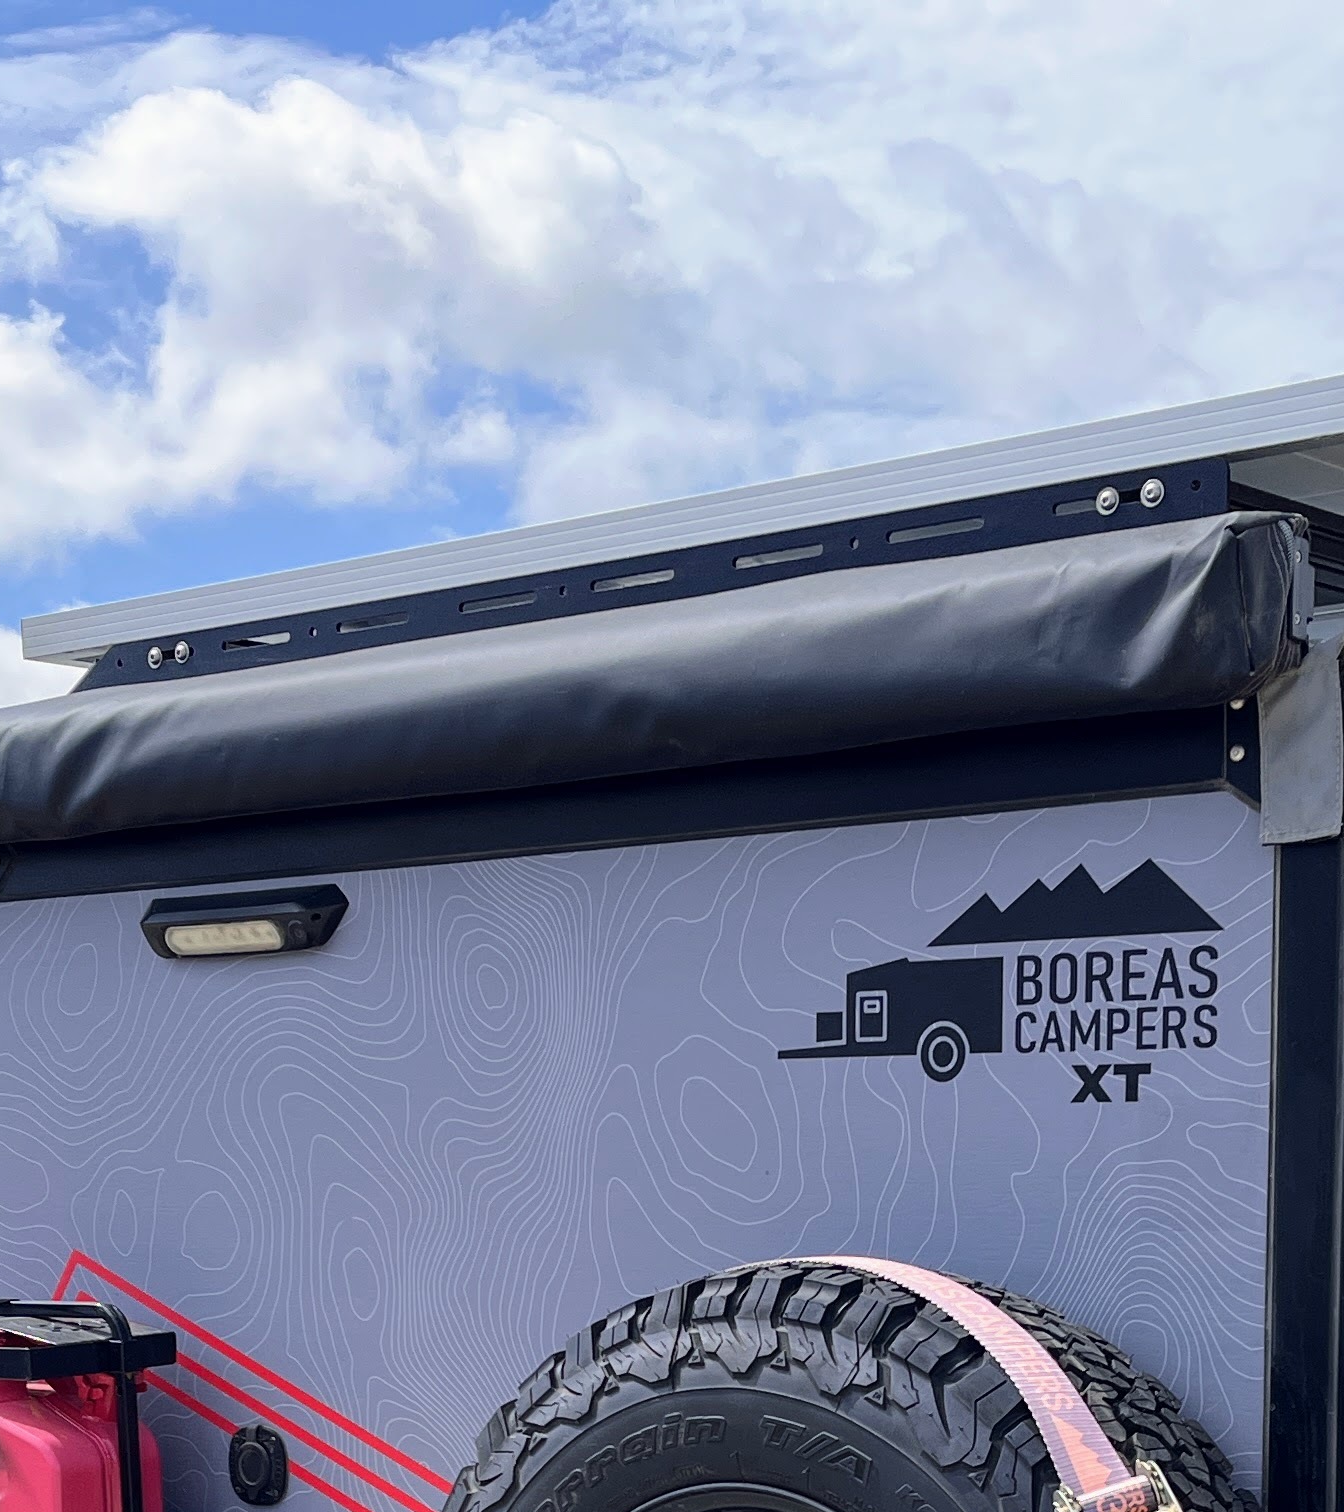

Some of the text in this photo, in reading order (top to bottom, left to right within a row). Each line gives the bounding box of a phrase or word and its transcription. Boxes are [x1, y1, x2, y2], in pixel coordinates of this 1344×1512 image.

[1015, 945, 1219, 1006] BOREAS
[1014, 1004, 1219, 1054] CAMPERS
[1070, 1062, 1152, 1104] XT
[758, 1414, 873, 1486] T/A
